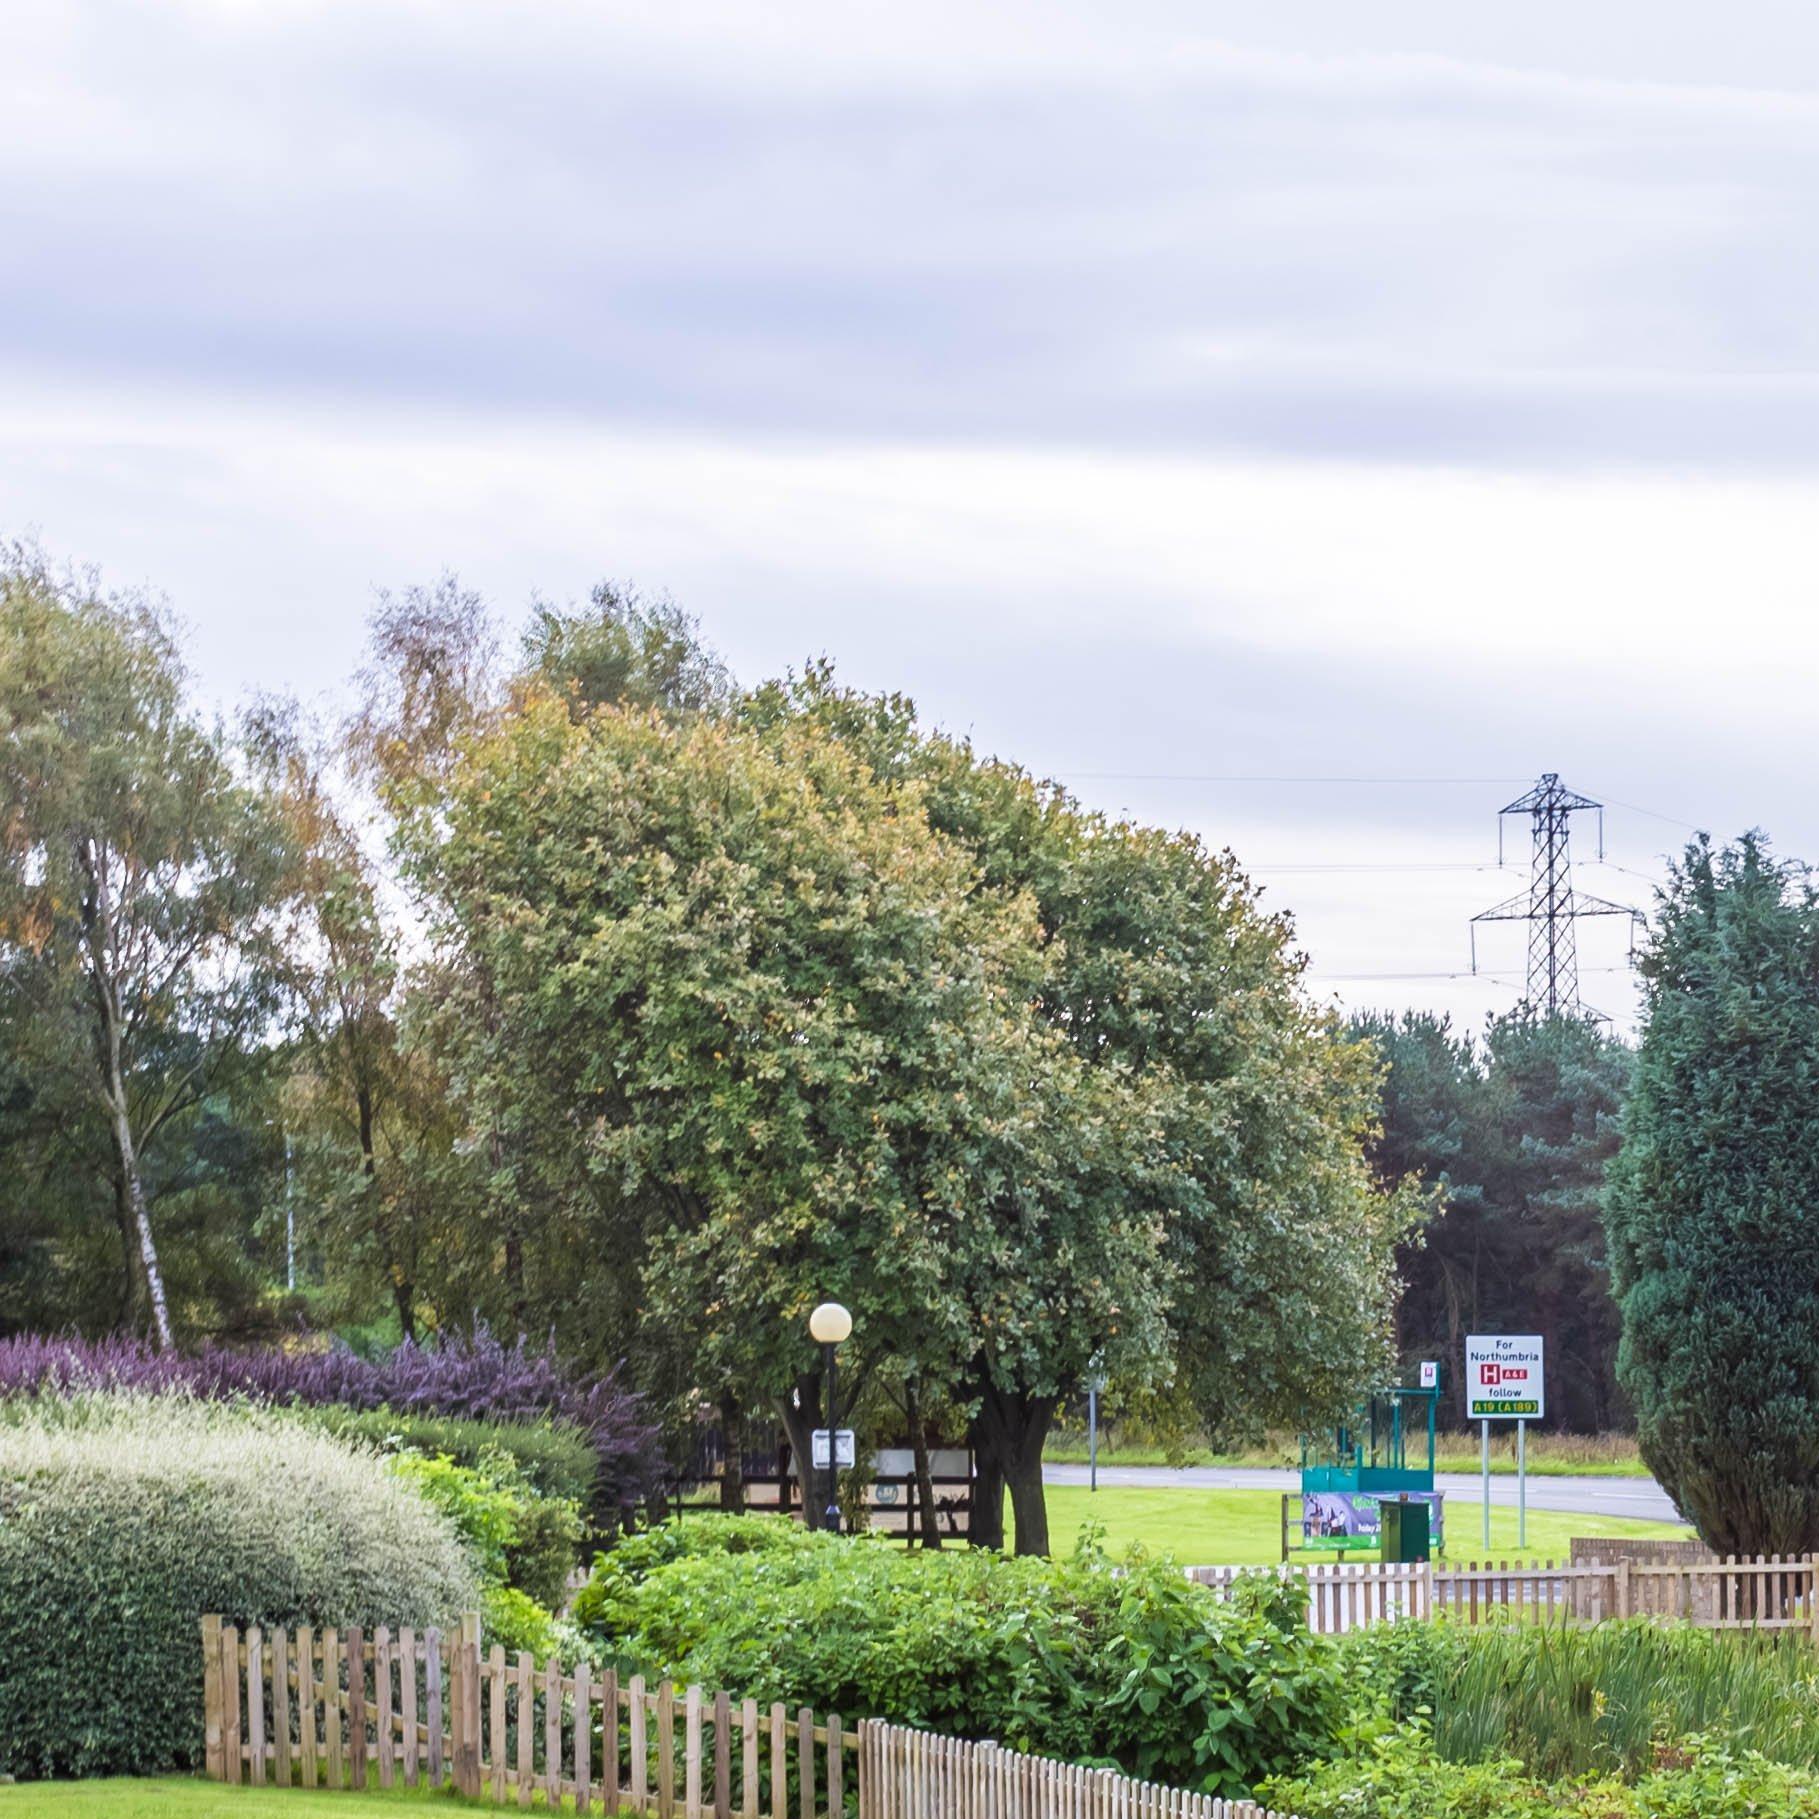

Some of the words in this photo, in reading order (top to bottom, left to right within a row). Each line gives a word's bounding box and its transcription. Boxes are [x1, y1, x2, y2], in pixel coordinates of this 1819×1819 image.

[1495, 1340, 1513, 1349] For
[1470, 1352, 1539, 1361] Northumbria
[1483, 1366, 1498, 1384] H
[1504, 1370, 1525, 1378] A&E
[1489, 1388, 1522, 1397] follow
[1474, 1401, 1495, 1412] A19
[1498, 1401, 1537, 1413] (A189)
